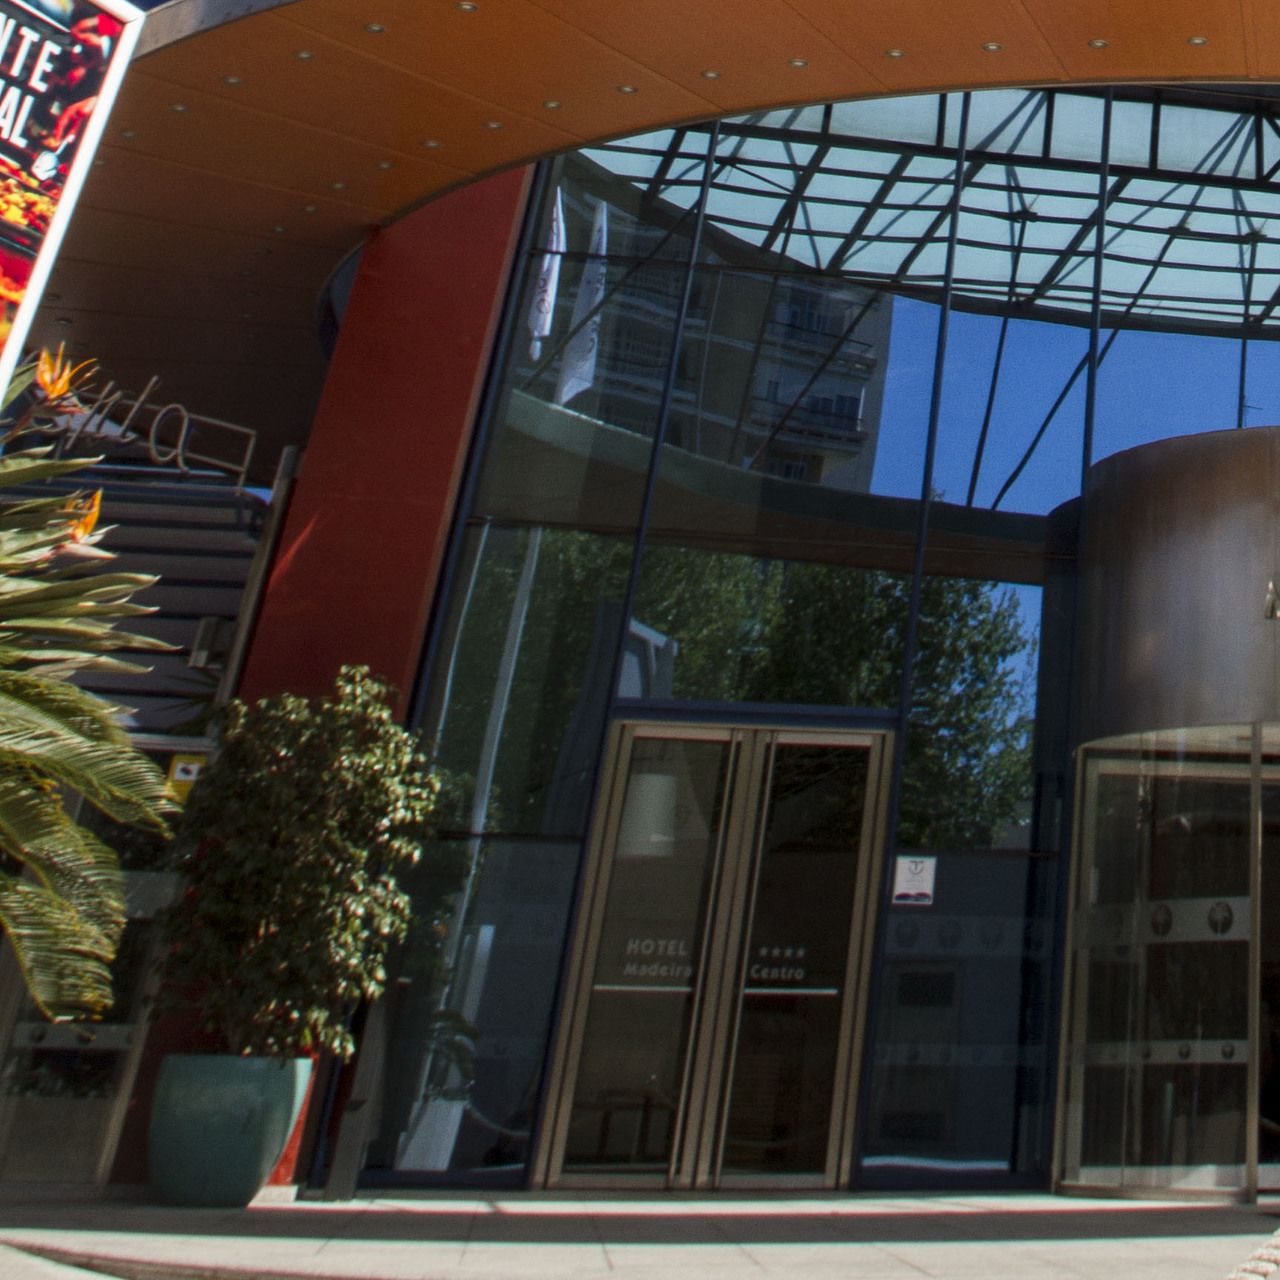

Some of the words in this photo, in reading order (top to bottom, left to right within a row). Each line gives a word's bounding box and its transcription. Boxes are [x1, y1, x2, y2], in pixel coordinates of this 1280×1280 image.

[627, 940, 688, 955] HOTEL
[624, 962, 693, 976] Madeira
[750, 964, 805, 979] Centro
